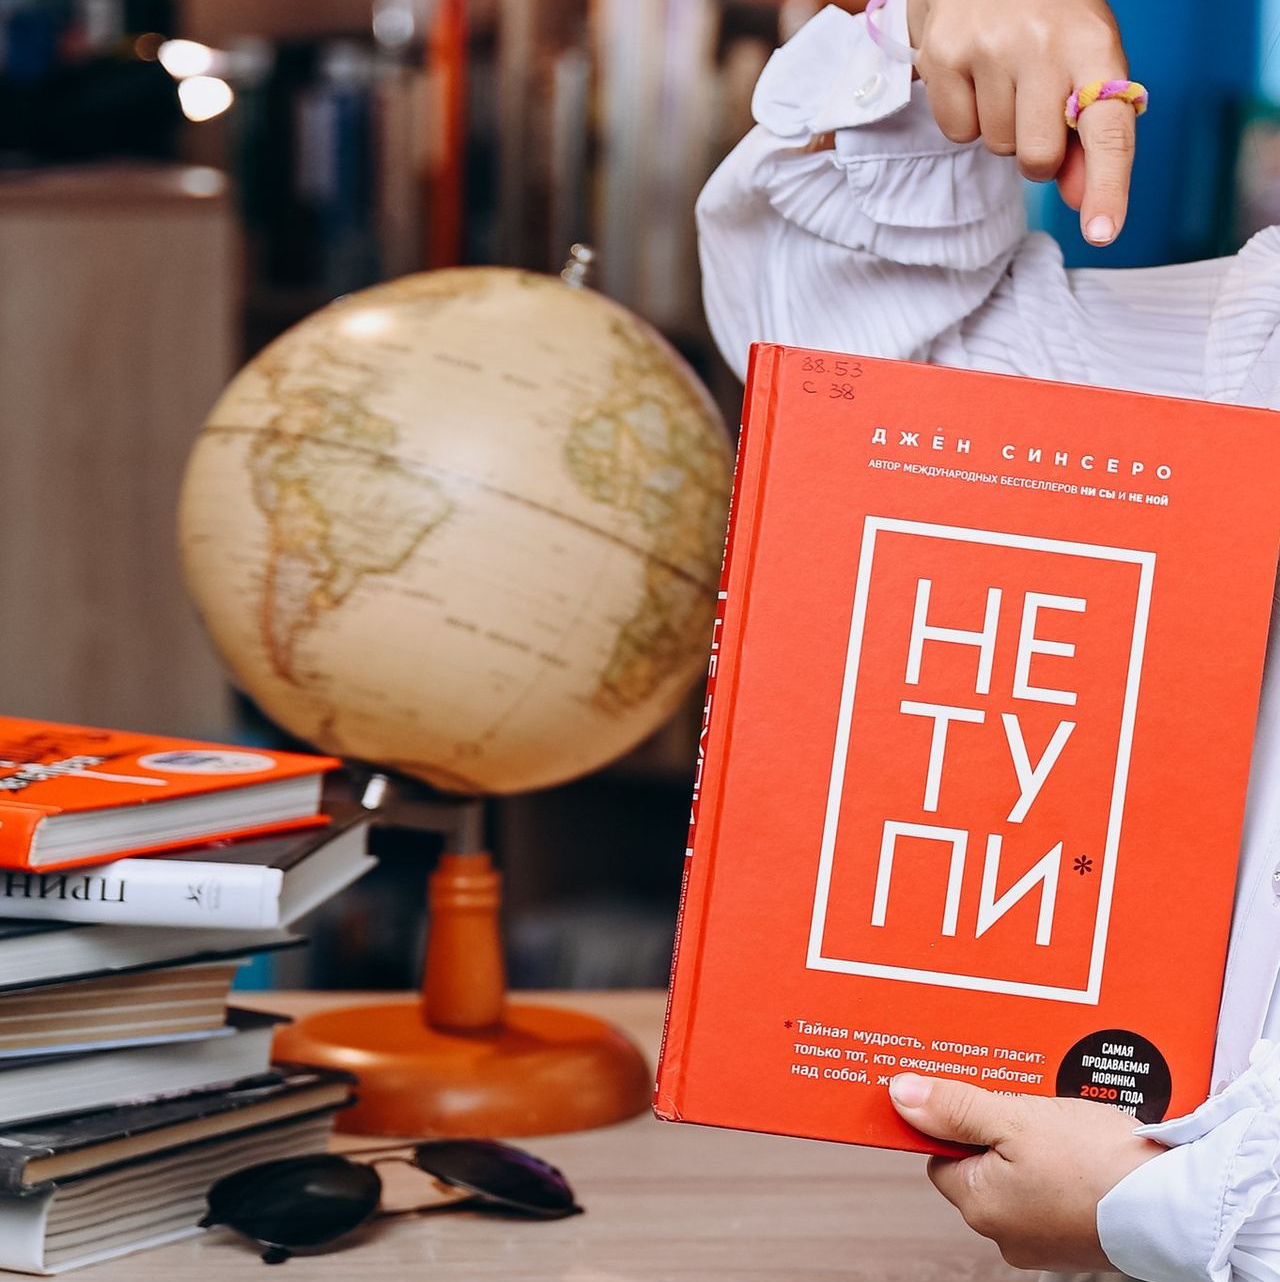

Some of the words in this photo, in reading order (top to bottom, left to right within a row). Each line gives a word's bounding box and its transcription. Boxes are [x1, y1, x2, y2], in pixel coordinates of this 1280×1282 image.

[802, 357, 862, 378] 88.53
[829, 383, 855, 400] 38
[871, 428, 971, 453] ДЖЕН
[1001, 445, 1172, 479] СИНСЕРО
[868, 459, 900, 471] АВТОР
[903, 463, 998, 484] МЕЖДУНАРОДНЫХ
[1000, 475, 1078, 495] БЕСТСЕЛЛЕРОВ
[1080, 486, 1096, 497] НИ
[1098, 488, 1116, 499] СЫ
[1118, 491, 1126, 501] И
[1128, 492, 1143, 503] НЕ
[1145, 494, 1169, 507] НОЙ
[904, 578, 1087, 706] НЕ
[899, 699, 1077, 824] ТУ
[796, 1019, 849, 1039] Тайная
[853, 1030, 926, 1051] мудрость,
[931, 1039, 989, 1058] которая
[993, 1047, 1046, 1065] гласит:
[1102, 1042, 1134, 1057] САМАЯ
[794, 1042, 841, 1059] только
[844, 1049, 869, 1064] тот,
[873, 1053, 896, 1066] кто
[899, 1056, 978, 1077] ежедневно
[981, 1066, 1044, 1085] работает
[1081, 1055, 1150, 1074] ПРОДАВАЕМАЯ
[791, 1064, 819, 1079] над
[823, 1068, 871, 1085] собой,
[1092, 1071, 1135, 1088] НОВИНКА
[1080, 1085, 1117, 1100] 2020
[1120, 1090, 1144, 1104] ГОДА
